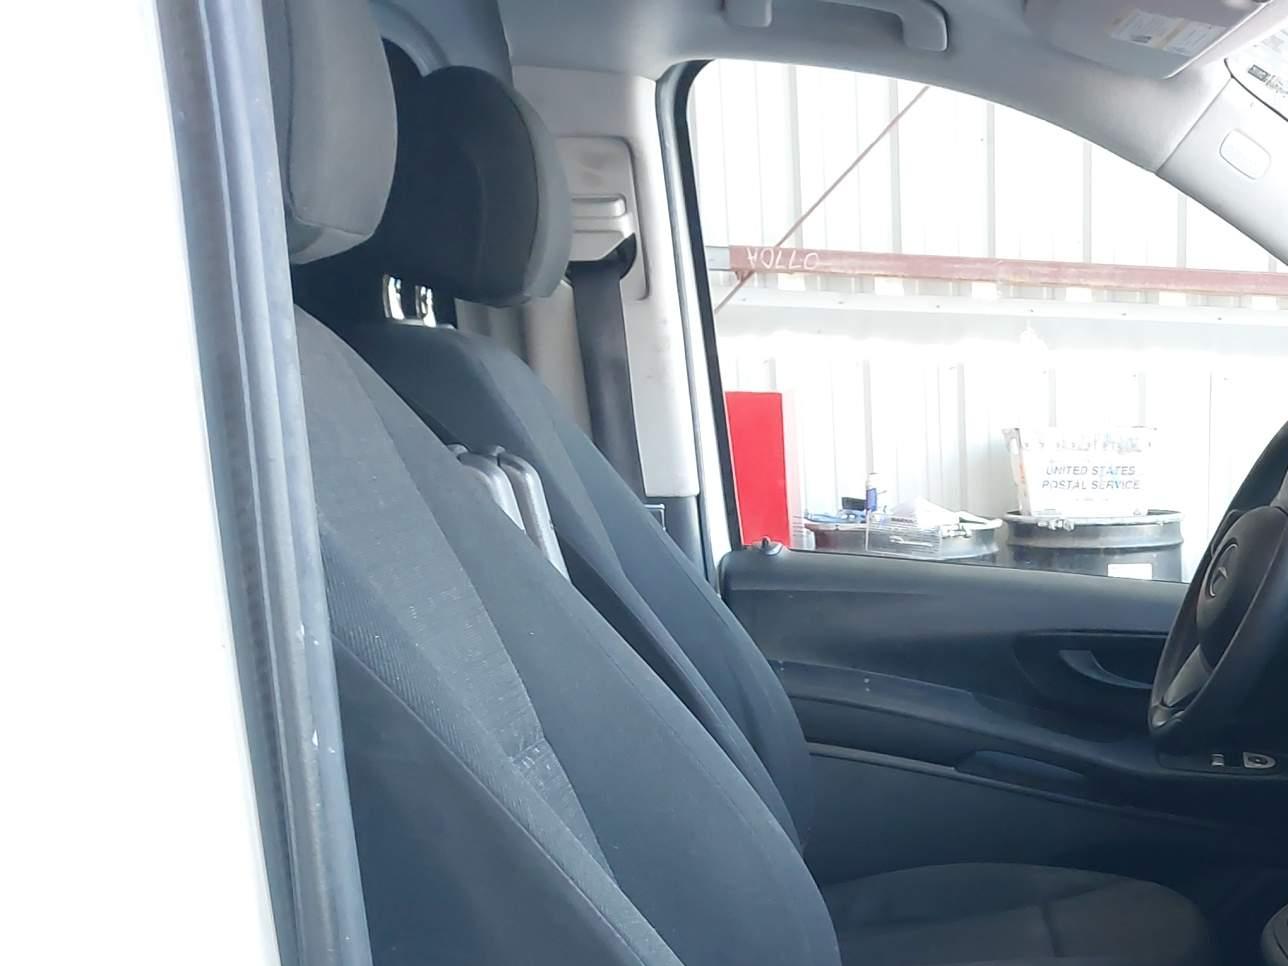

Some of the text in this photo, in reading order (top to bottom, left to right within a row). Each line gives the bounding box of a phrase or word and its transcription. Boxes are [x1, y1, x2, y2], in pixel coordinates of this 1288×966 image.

[1046, 466, 1136, 476] UNITED STATES
[1042, 480, 1142, 490] POSTAL SERVICE
